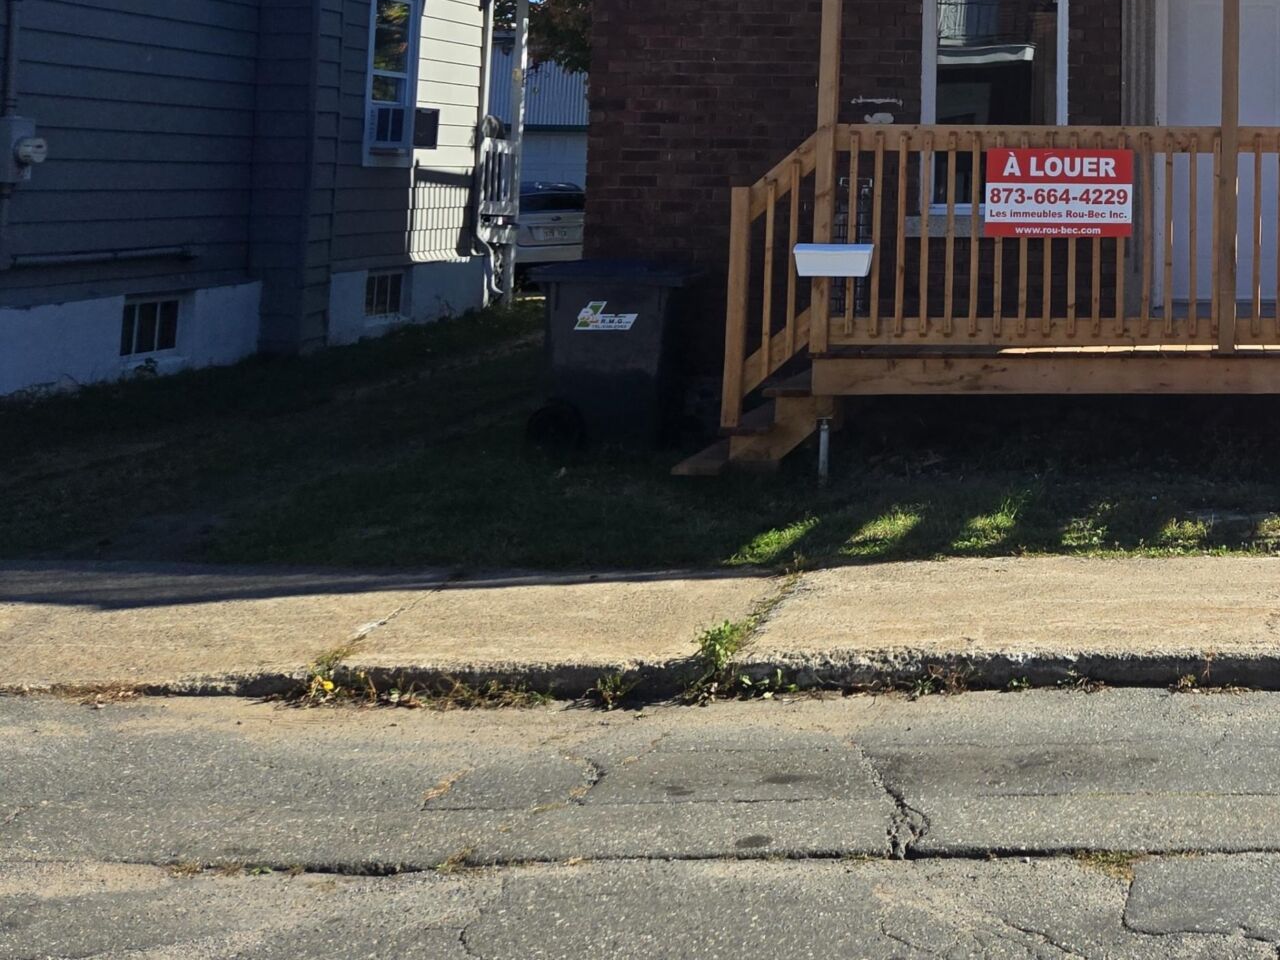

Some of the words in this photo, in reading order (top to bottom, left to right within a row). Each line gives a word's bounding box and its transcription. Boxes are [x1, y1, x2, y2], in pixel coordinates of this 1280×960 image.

[1003, 152, 1021, 177] À
[1030, 156, 1117, 178] LOUER
[989, 188, 1128, 205] 873-664-4229
[989, 209, 1007, 218] Les
[1010, 209, 1063, 218] immeubles
[1066, 209, 1107, 219] Rou-Bec
[1109, 210, 1128, 219] Inc.
[1015, 225, 1102, 235] www.rou-bec.com
